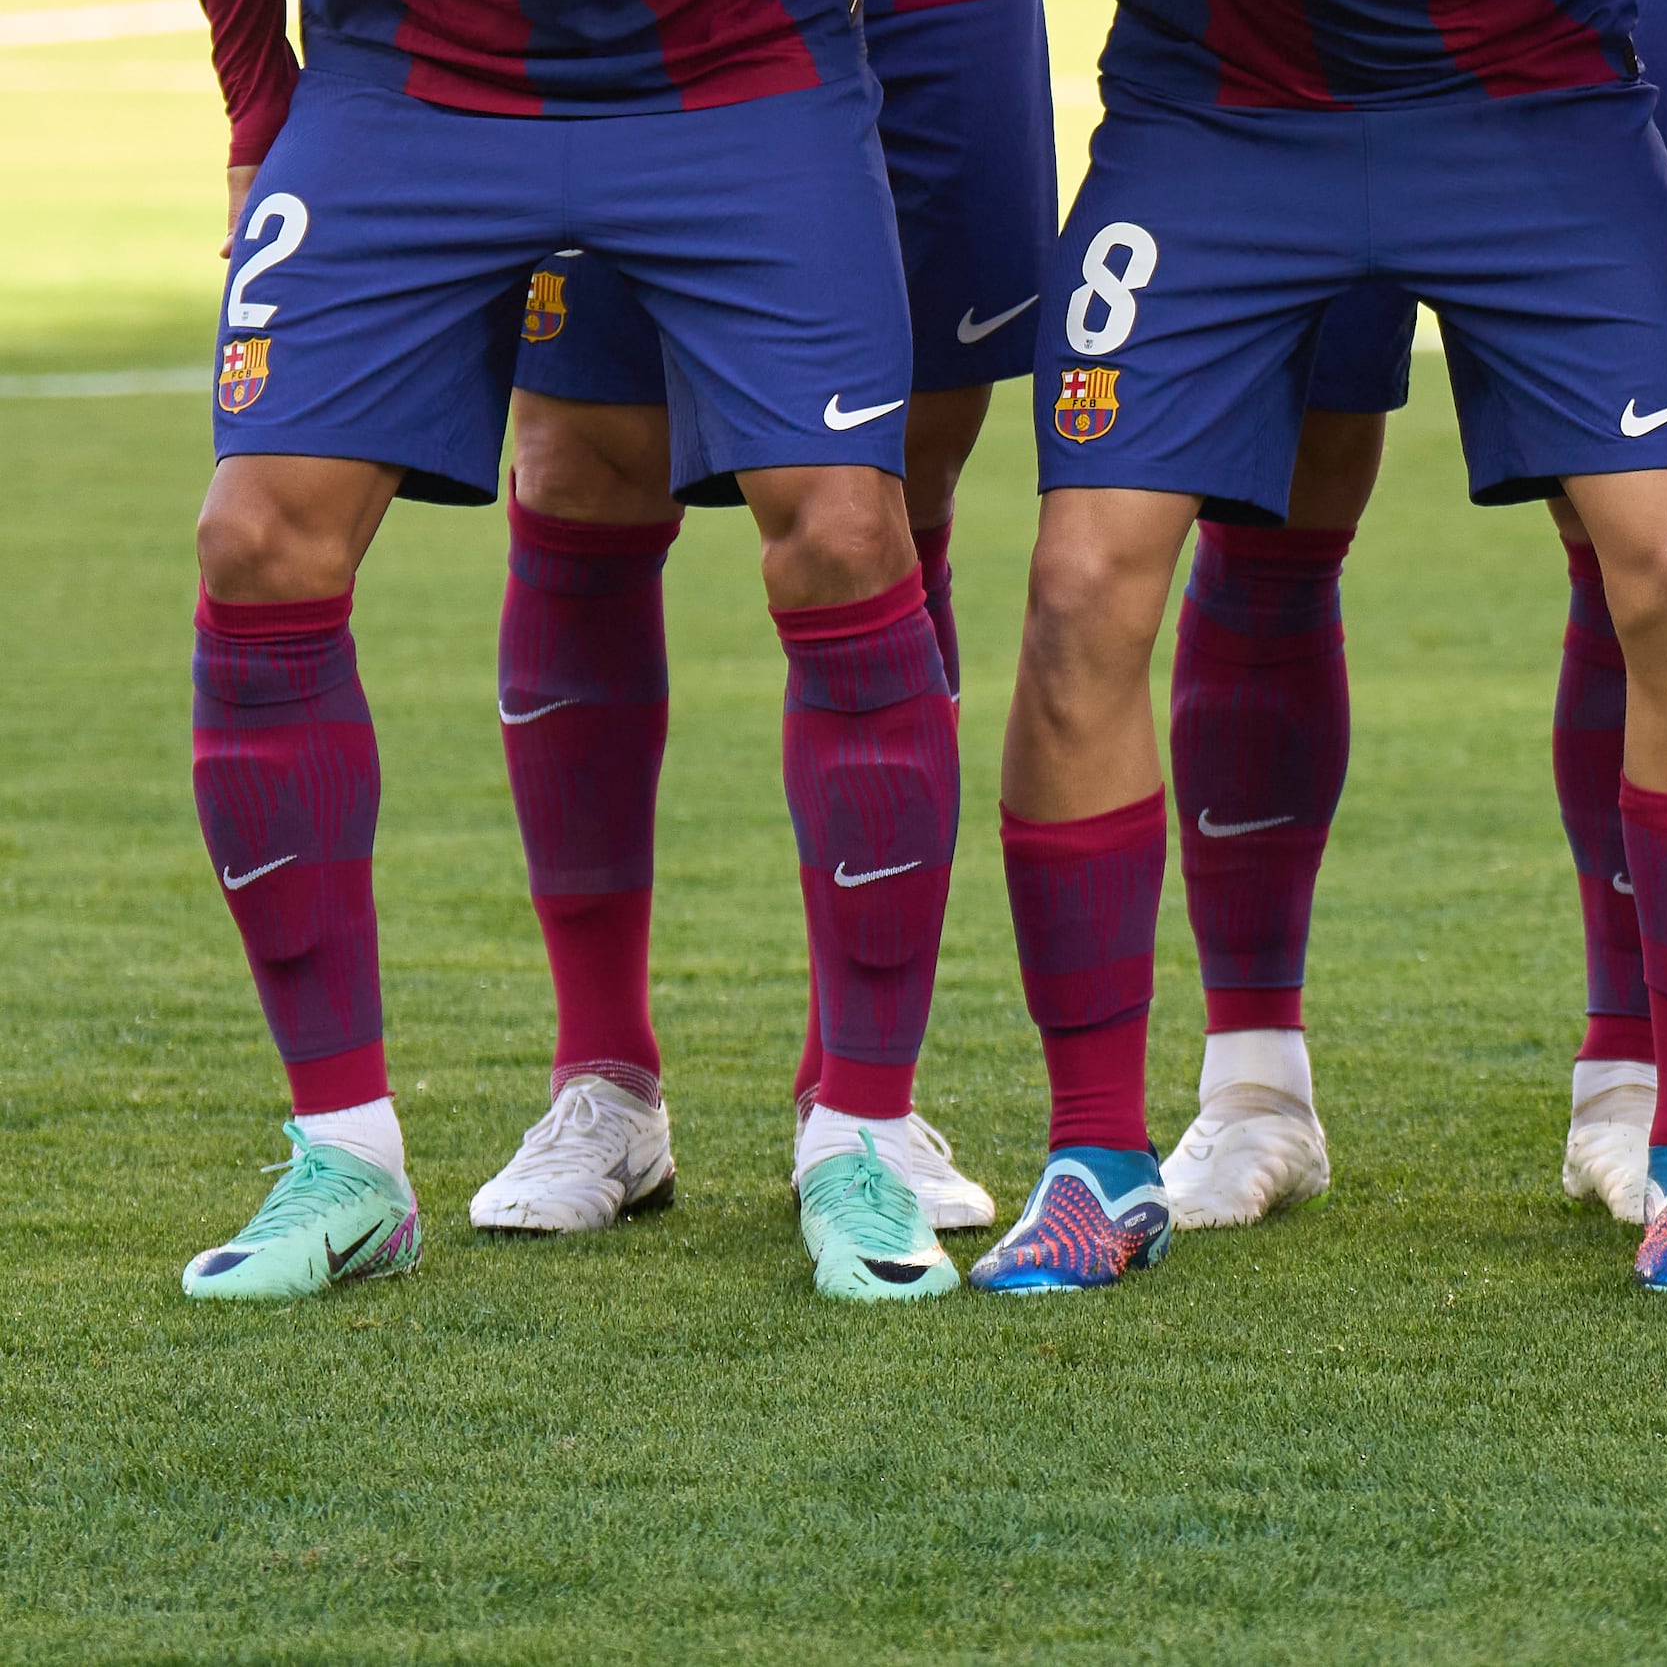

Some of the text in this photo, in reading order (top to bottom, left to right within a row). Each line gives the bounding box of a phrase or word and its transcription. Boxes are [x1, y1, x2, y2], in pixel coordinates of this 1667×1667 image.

[227, 192, 309, 329] 2
[1066, 221, 1158, 356] 8
[528, 299, 545, 311] CB
[231, 368, 253, 380] FCB
[1072, 398, 1097, 409] FCB
